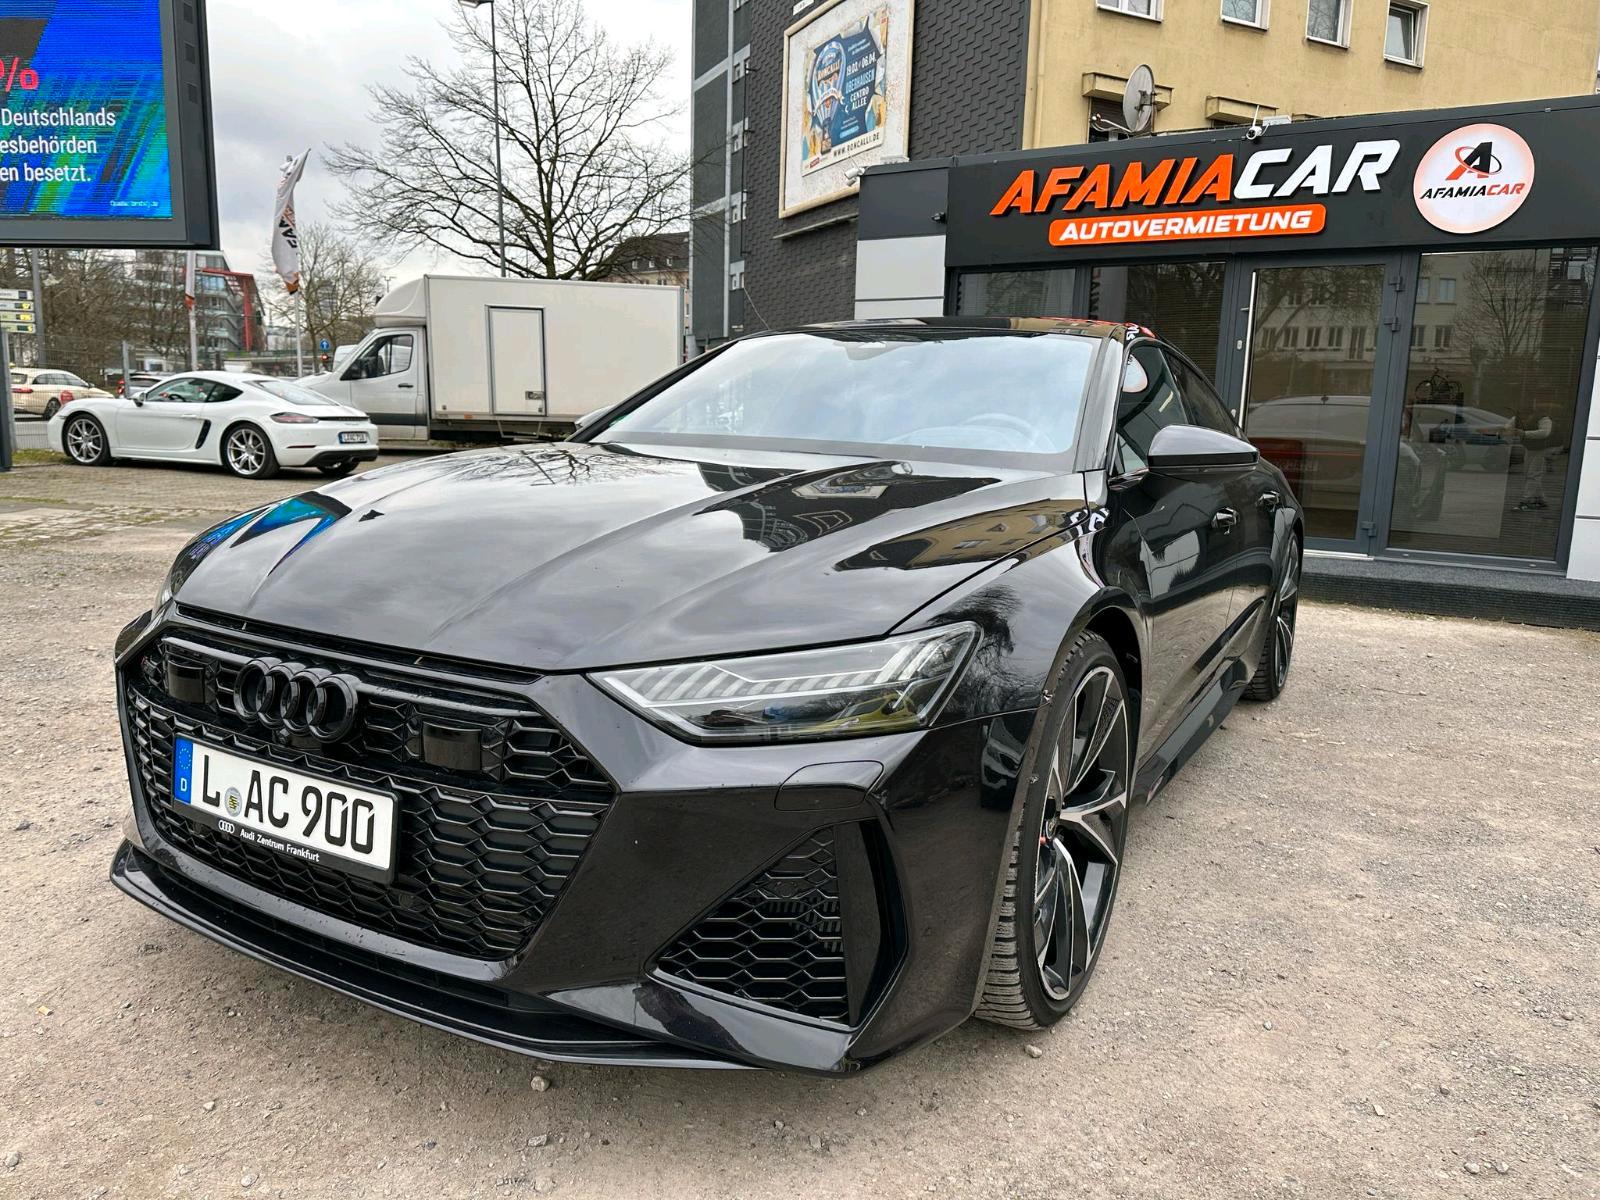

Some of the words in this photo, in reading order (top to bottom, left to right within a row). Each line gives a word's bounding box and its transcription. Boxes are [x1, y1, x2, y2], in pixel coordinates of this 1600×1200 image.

[1, 107, 116, 127] Deutschlands
[24, 163, 91, 182] besetzt.
[989, 139, 1400, 216] AFAMIACAR
[1420, 183, 1525, 200] AFAMIACAR
[1059, 210, 1312, 241] AUTOVERMIETUNG
[180, 777, 187, 792] D
[202, 754, 221, 807] L
[244, 769, 290, 828] AC
[301, 785, 375, 855] 900
[240, 828, 255, 841] Audi
[257, 833, 285, 851] Zentrum
[286, 843, 320, 862] Frankfurt
